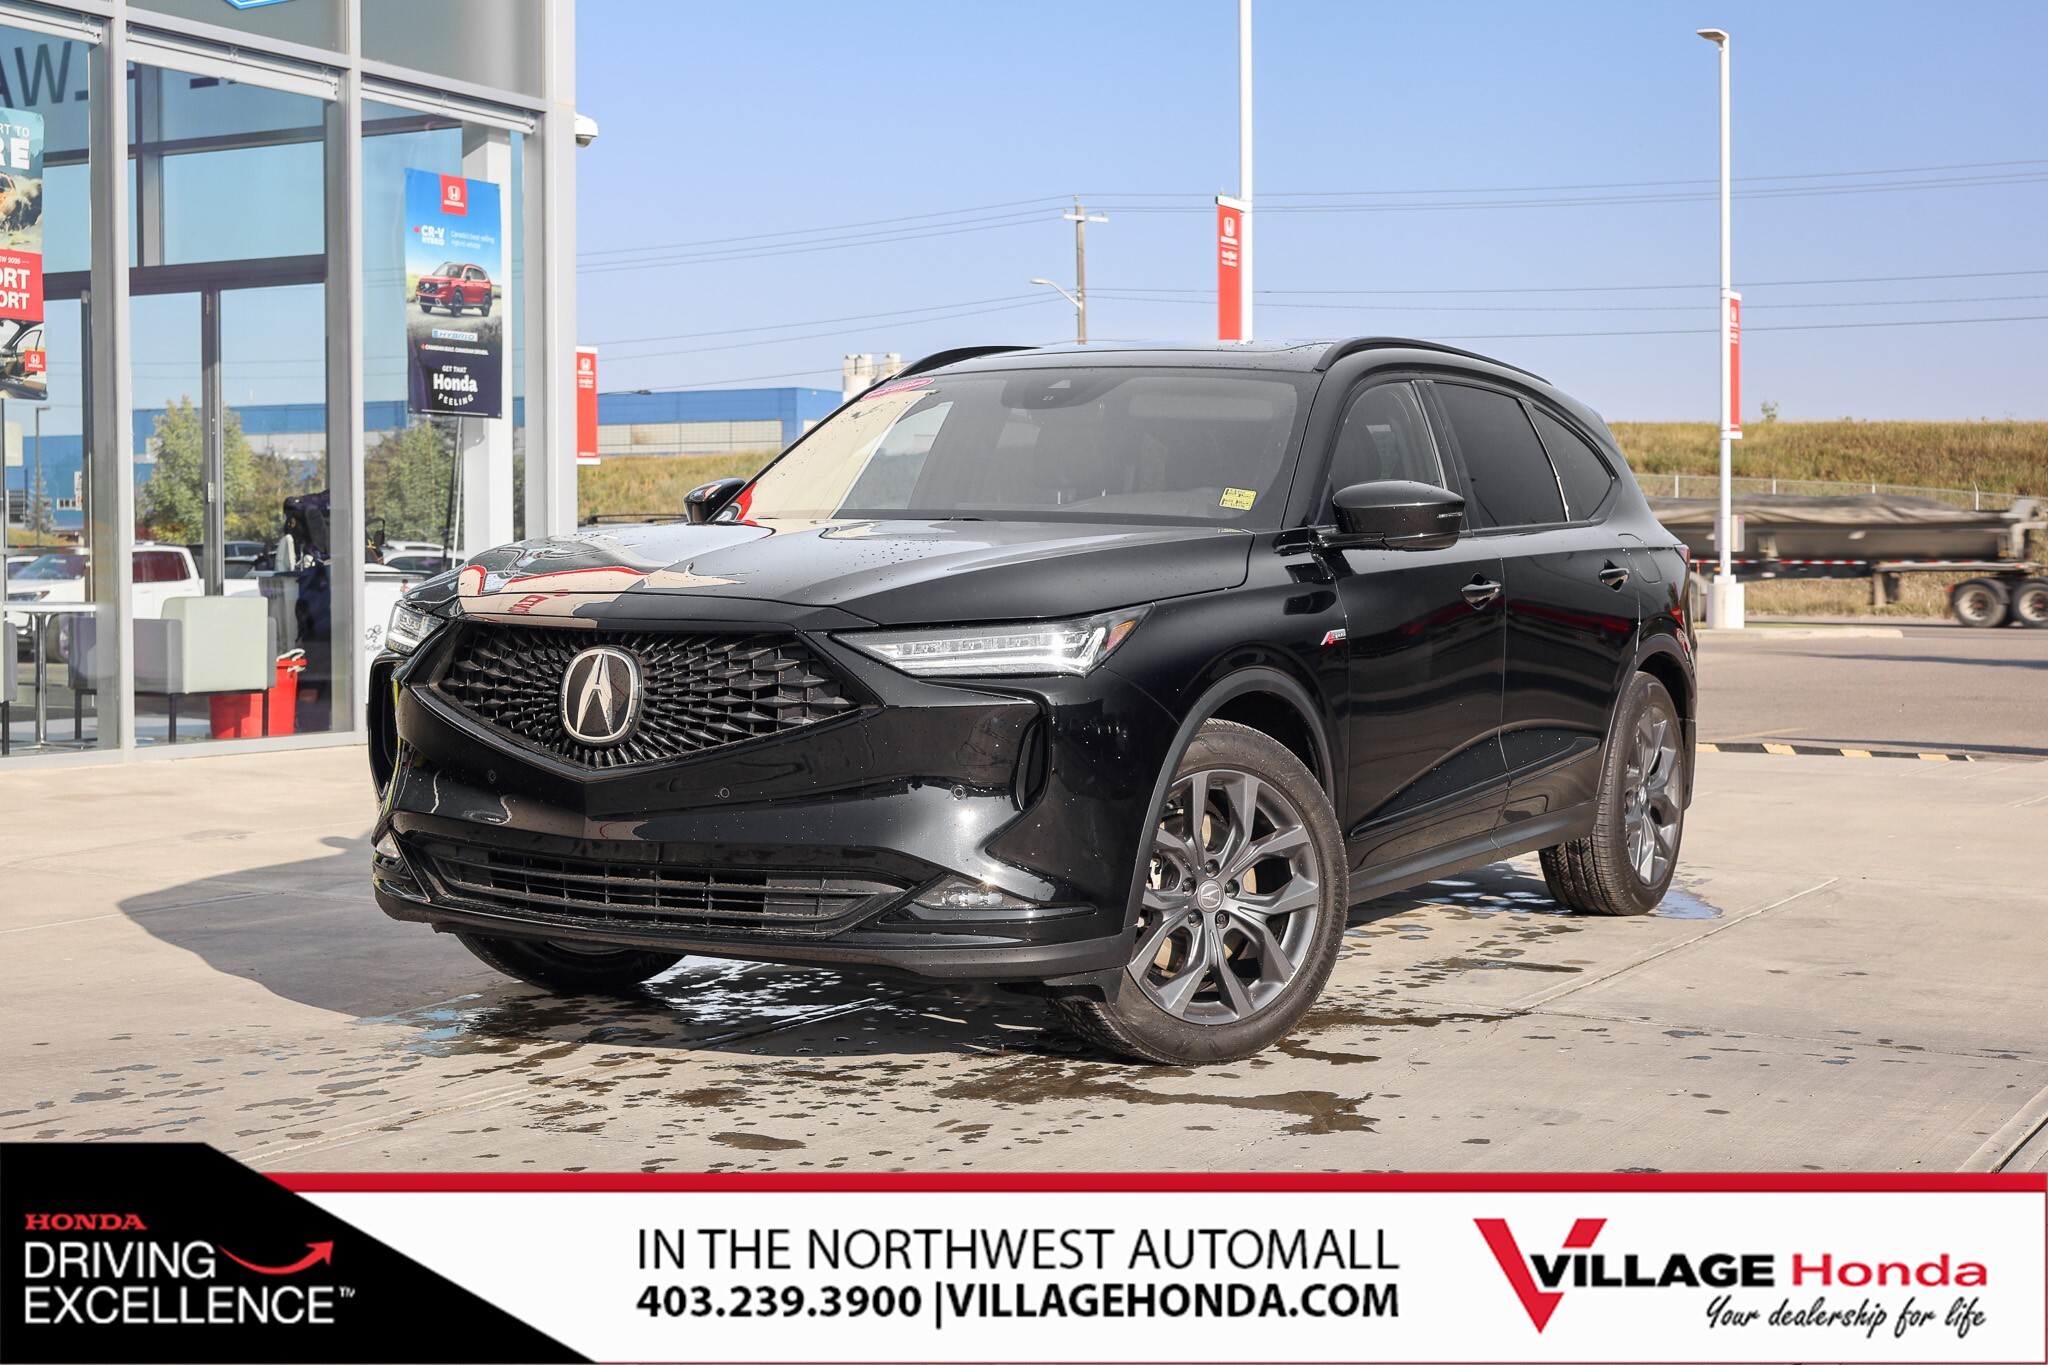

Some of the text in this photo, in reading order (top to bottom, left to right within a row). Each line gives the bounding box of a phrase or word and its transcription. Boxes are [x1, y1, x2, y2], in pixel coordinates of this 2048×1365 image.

[15, 125, 30, 138] TO
[421, 225, 445, 239] CR-V
[421, 236, 445, 246] HYBRID
[438, 331, 475, 341] HYBRID
[453, 366, 467, 374] THAT
[433, 373, 478, 392] Honda
[438, 393, 474, 406] FEELING
